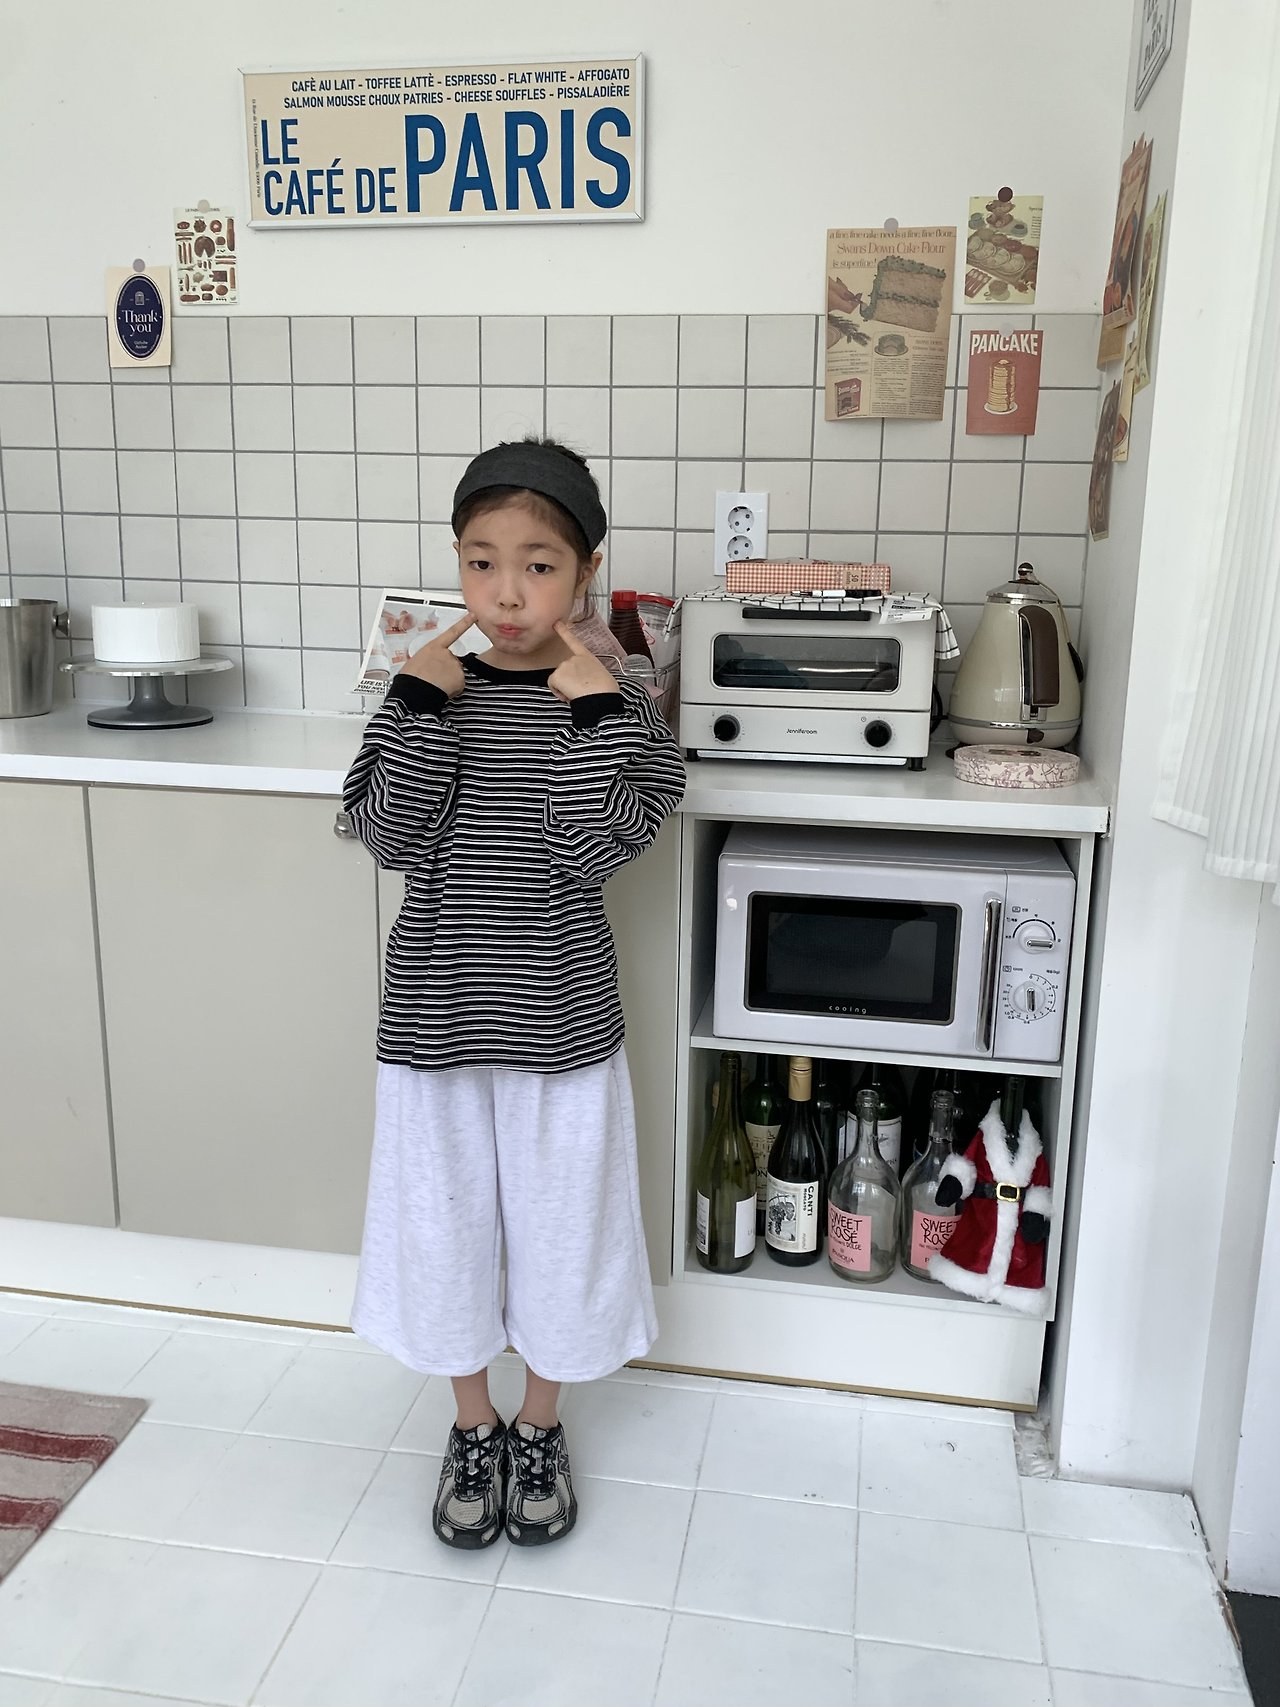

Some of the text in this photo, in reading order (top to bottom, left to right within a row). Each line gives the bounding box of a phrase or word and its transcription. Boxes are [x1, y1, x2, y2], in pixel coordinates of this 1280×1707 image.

[292, 77, 316, 92] CAFÈ
[319, 79, 332, 91] AU
[334, 78, 356, 91] LAIT
[365, 78, 401, 90] TOFFEE
[404, 73, 434, 88] LATTÈ
[445, 73, 497, 86] ESPRESSO
[508, 72, 532, 84] FLAT
[535, 70, 567, 84] WHITE
[578, 68, 630, 82] AFFOGATO
[284, 96, 324, 109] SALMON
[326, 94, 366, 108] MOUSSE
[368, 93, 401, 106] CHOUX
[403, 92, 444, 104] PATRIES
[454, 90, 493, 103] CHEESE
[496, 88, 546, 101] SOUFFLES
[557, 83, 630, 99] PISSALADIÈRE
[261, 118, 300, 164] LE
[264, 107, 631, 216] CAFÉ DE PARIS
[837, 241, 946, 254] Swans Down Cake Flour
[122, 310, 158, 324] Thank
[130, 324, 152, 336] you
[971, 334, 1038, 356] PANCAKE
[830, 1208, 862, 1231] SWEET
[924, 1229, 951, 1246] ROS
